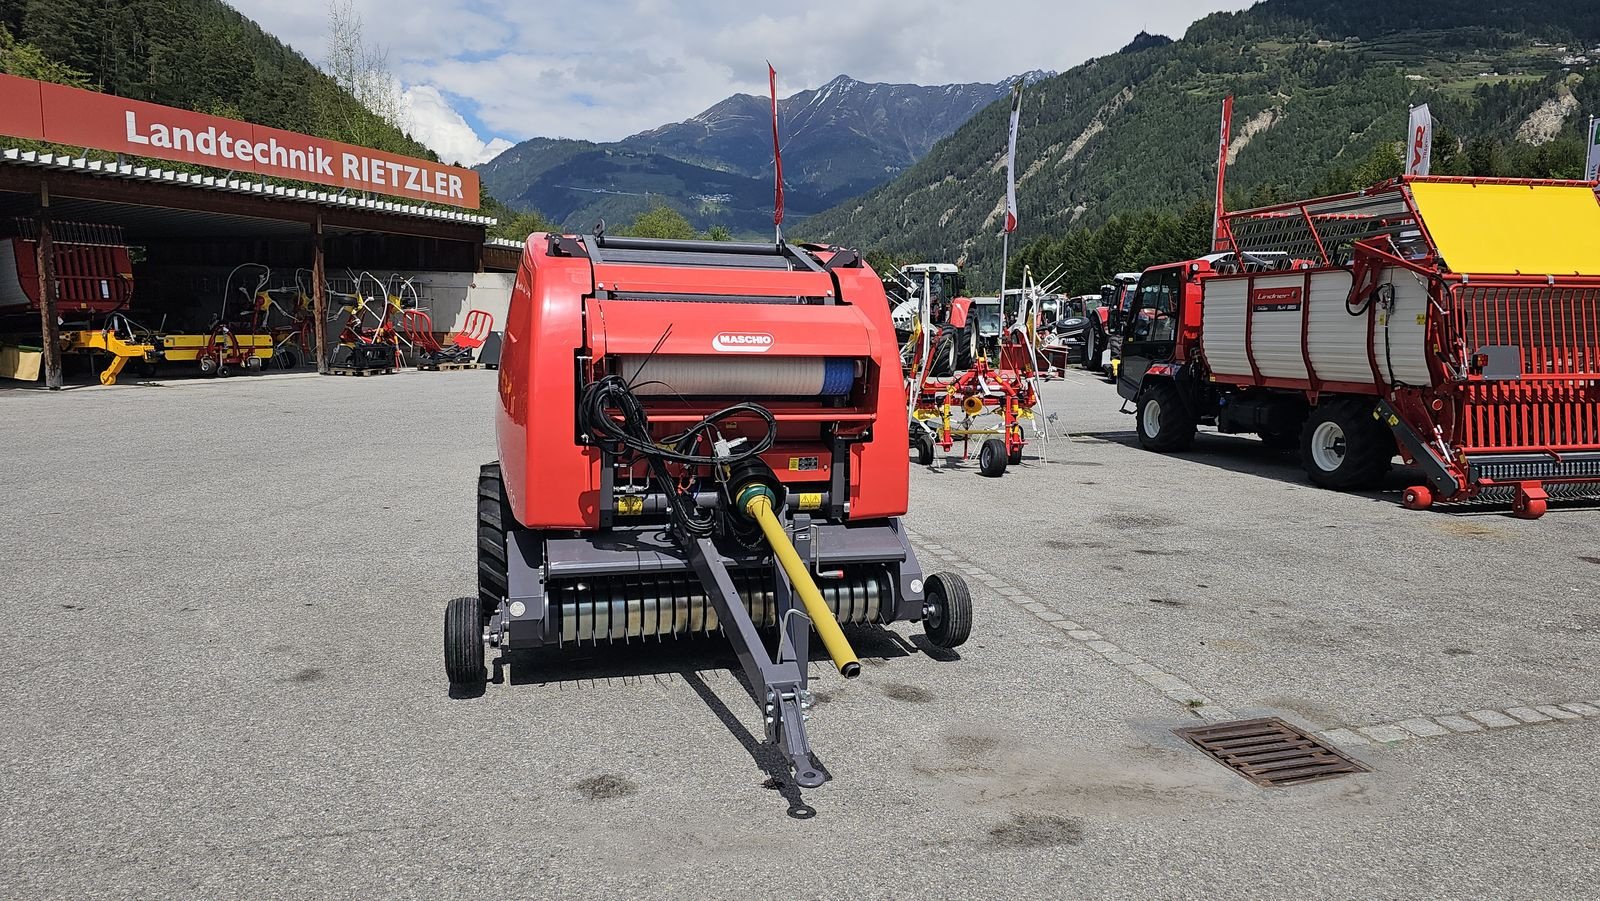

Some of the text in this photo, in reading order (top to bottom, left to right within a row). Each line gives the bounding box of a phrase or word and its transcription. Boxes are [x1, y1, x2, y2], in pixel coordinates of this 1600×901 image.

[125, 110, 464, 199] Landtechnik RIETZLER
[1257, 292, 1290, 300] Lindner
[720, 335, 771, 344] MASCHIO
